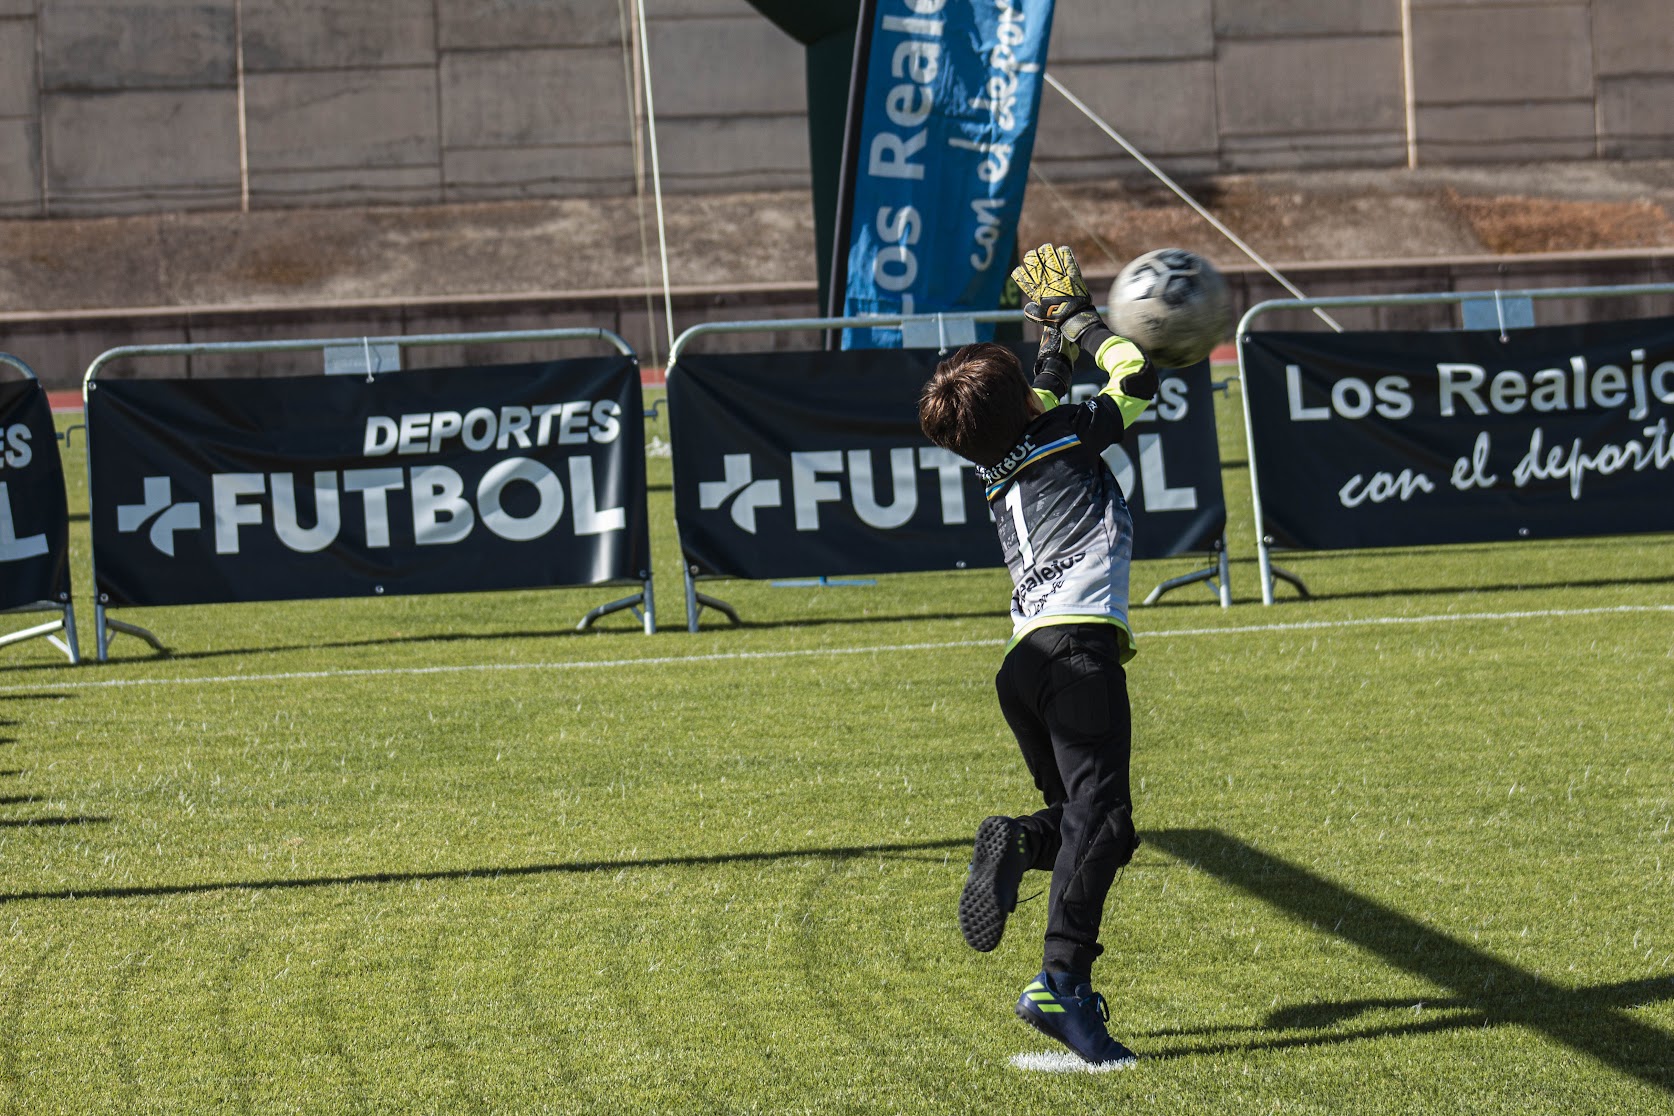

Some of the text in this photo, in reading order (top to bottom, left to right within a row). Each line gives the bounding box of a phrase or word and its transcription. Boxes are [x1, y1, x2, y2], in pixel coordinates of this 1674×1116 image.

[948, 142, 1013, 184] el
[970, 198, 1006, 271] con
[363, 399, 622, 457] DEPORTES
[1285, 364, 1415, 422] Los
[791, 433, 1199, 532] FUTL
[1338, 417, 1674, 509] con el deport
[211, 455, 626, 555] FUTBOL
[1005, 480, 1035, 573] 1
